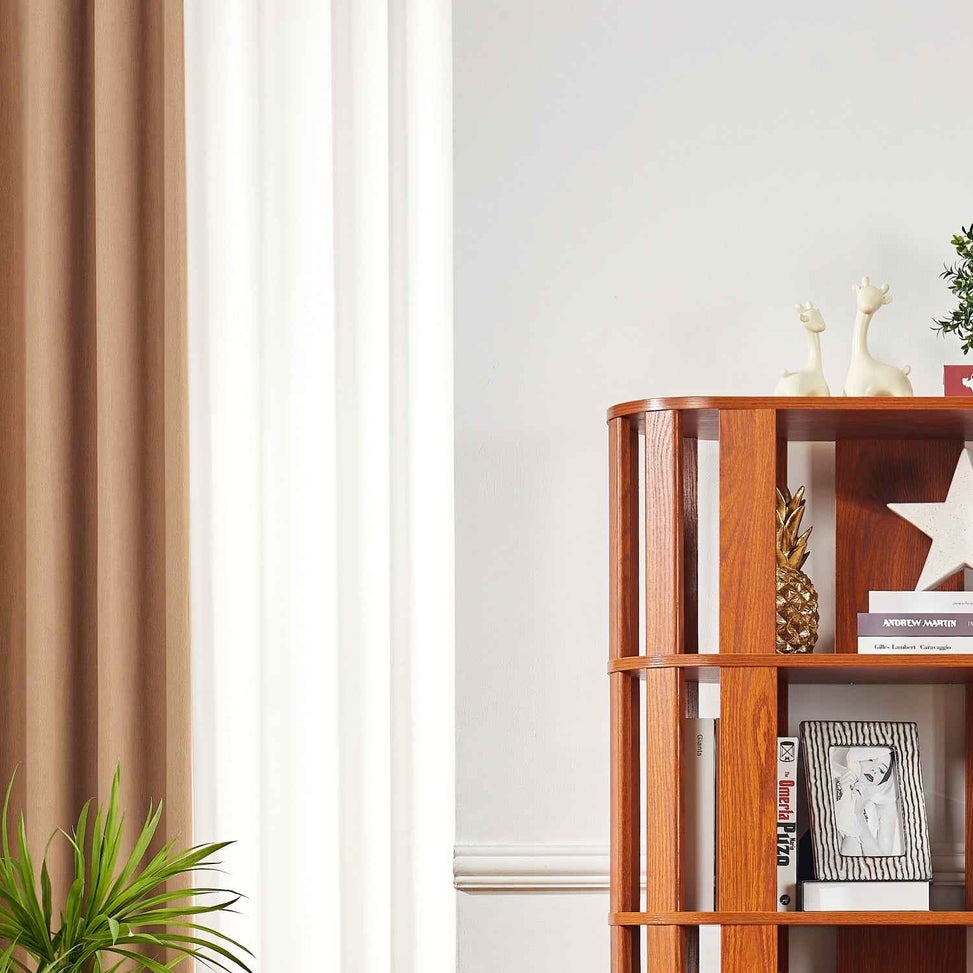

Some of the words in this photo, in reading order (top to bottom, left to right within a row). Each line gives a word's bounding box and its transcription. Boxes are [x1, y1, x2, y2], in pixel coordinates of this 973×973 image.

[882, 619, 921, 627] ANDREW
[923, 619, 957, 627] MARTIN
[778, 780, 795, 821] Omerta
[777, 823, 796, 866] Puzo
